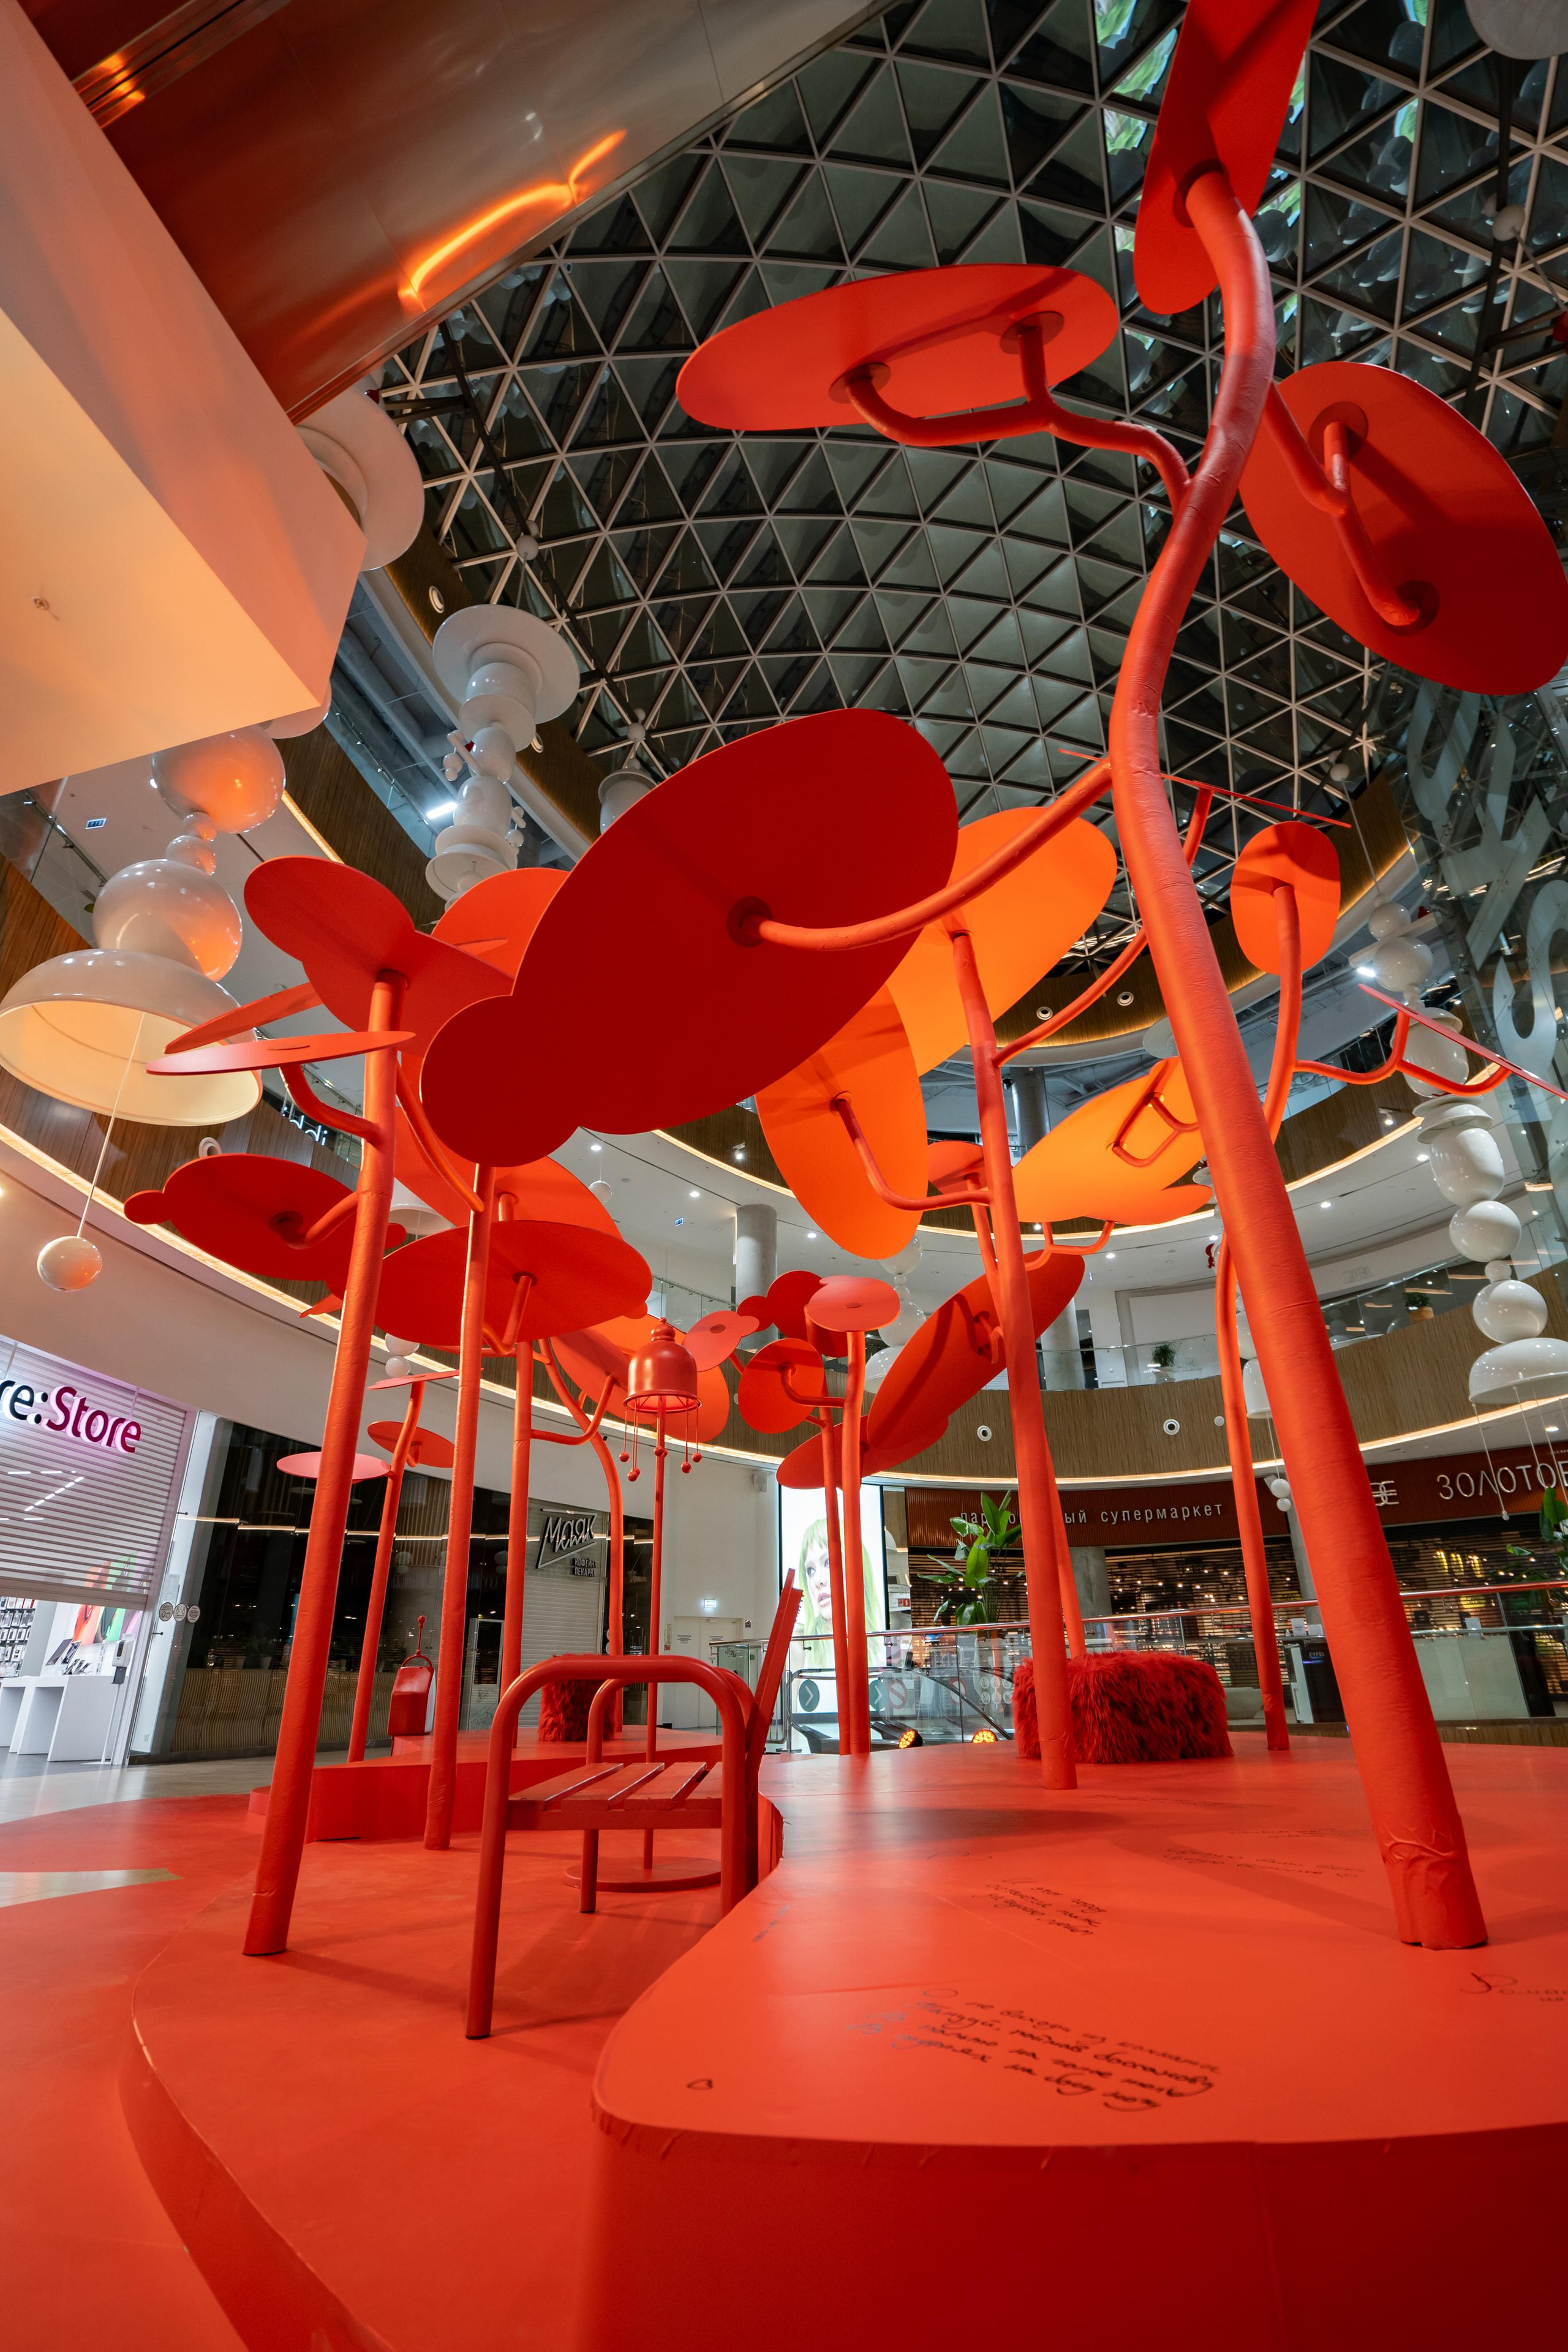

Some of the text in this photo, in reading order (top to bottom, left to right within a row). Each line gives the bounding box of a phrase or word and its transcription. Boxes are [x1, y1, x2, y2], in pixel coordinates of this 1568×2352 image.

[0, 1379, 141, 1453] re:Store
[1100, 1504, 1223, 1525] супермаркет
[573, 1567, 597, 1577] ПЕКАРНЯ
